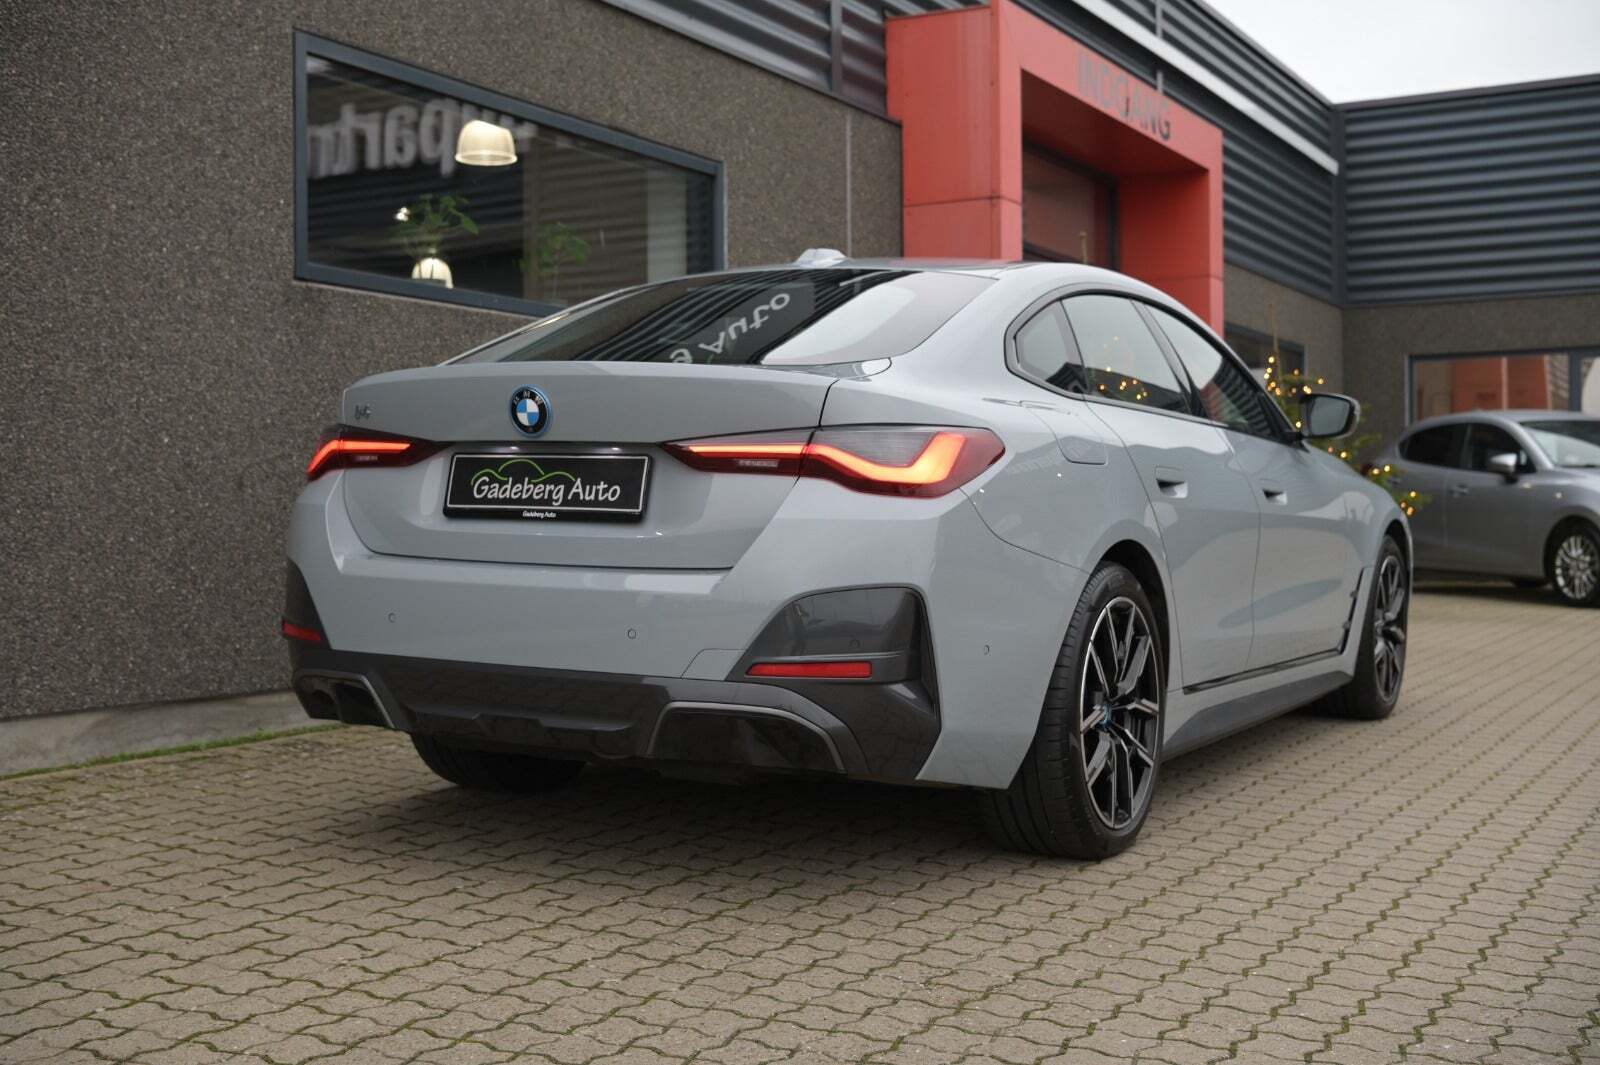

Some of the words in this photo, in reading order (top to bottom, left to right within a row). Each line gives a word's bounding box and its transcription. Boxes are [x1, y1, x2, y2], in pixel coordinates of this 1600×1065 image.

[1077, 53, 1171, 141] INDGANG
[473, 476, 564, 506] Gadeberg
[568, 478, 621, 502] Auto
